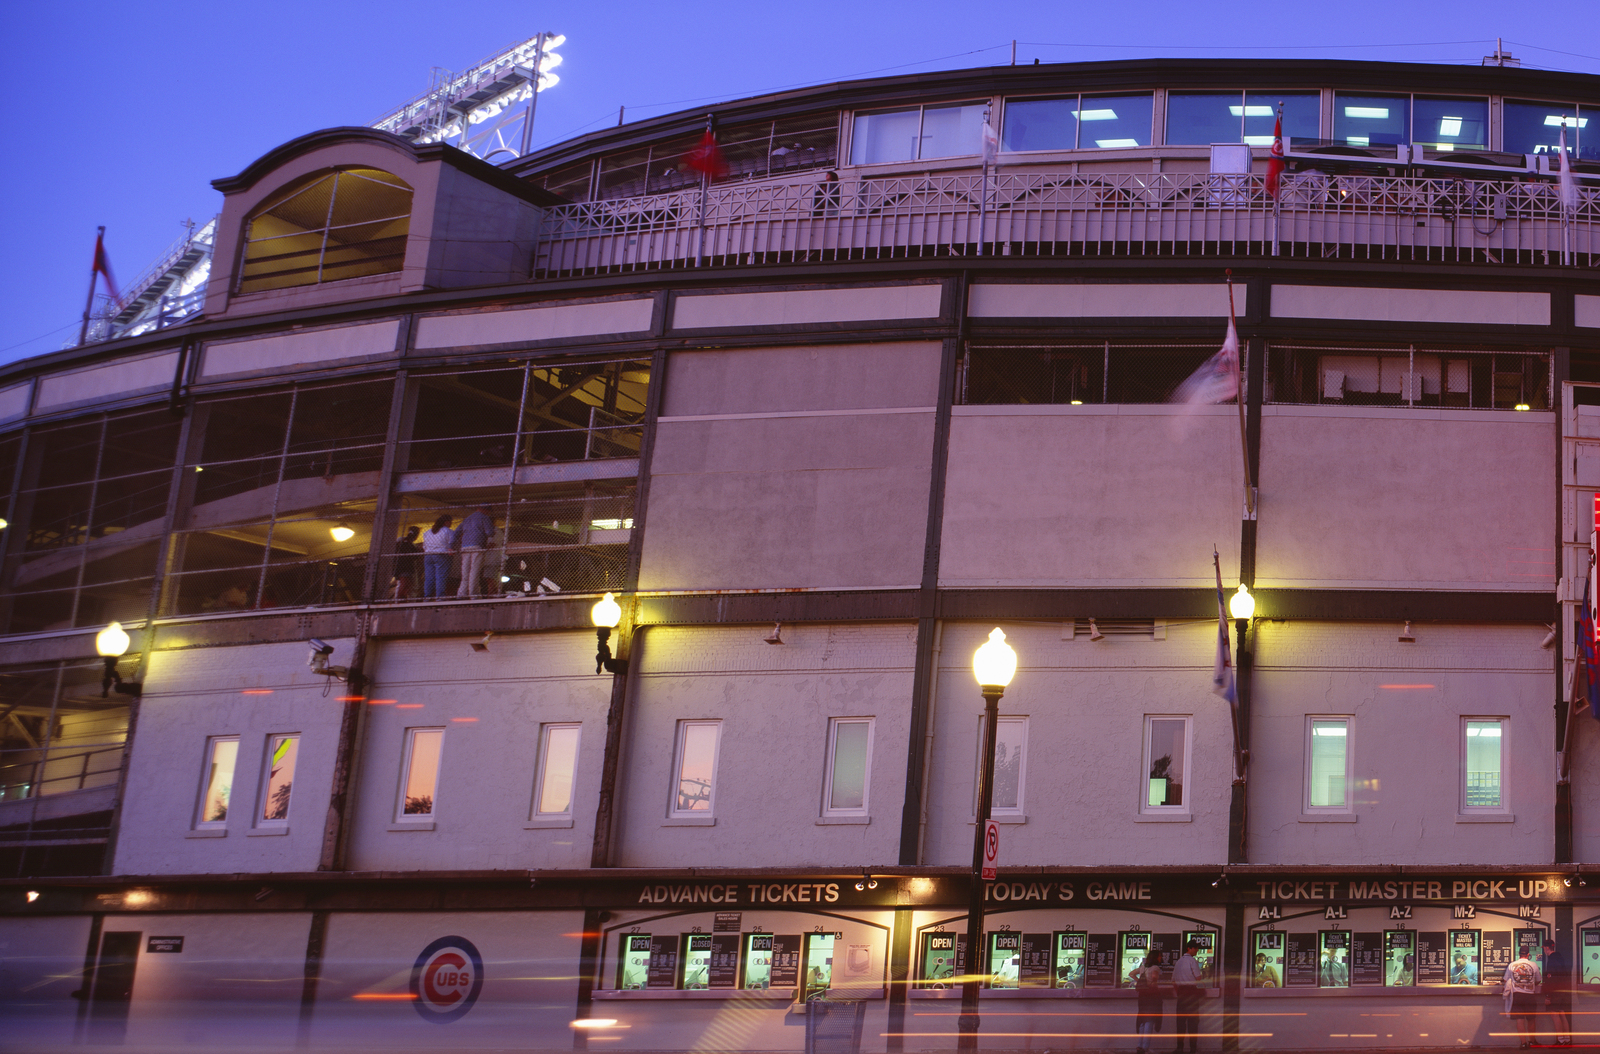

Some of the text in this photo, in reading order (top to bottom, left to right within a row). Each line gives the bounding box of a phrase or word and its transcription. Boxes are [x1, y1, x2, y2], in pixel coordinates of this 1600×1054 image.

[638, 883, 840, 903] ADVANCE TICKETS
[984, 882, 1152, 902] TODAY'S GAME
[1257, 880, 1548, 900] TICKET MASTER PICK-UP
[1259, 906, 1281, 918] A-L
[1325, 906, 1347, 918] A-L
[1390, 906, 1412, 918] A-Z
[1455, 906, 1475, 918] M-Z
[1520, 905, 1540, 917] M-Z
[632, 940, 650, 949] OPEN
[753, 938, 771, 949] OPEN
[932, 937, 952, 948] OPEN
[998, 937, 1017, 948] OPEN
[1063, 936, 1083, 947] OPEN
[1128, 937, 1147, 947] OPEN
[1192, 937, 1210, 946] PEN
[1260, 935, 1281, 948] A-L
[424, 953, 469, 1006] CUBS
